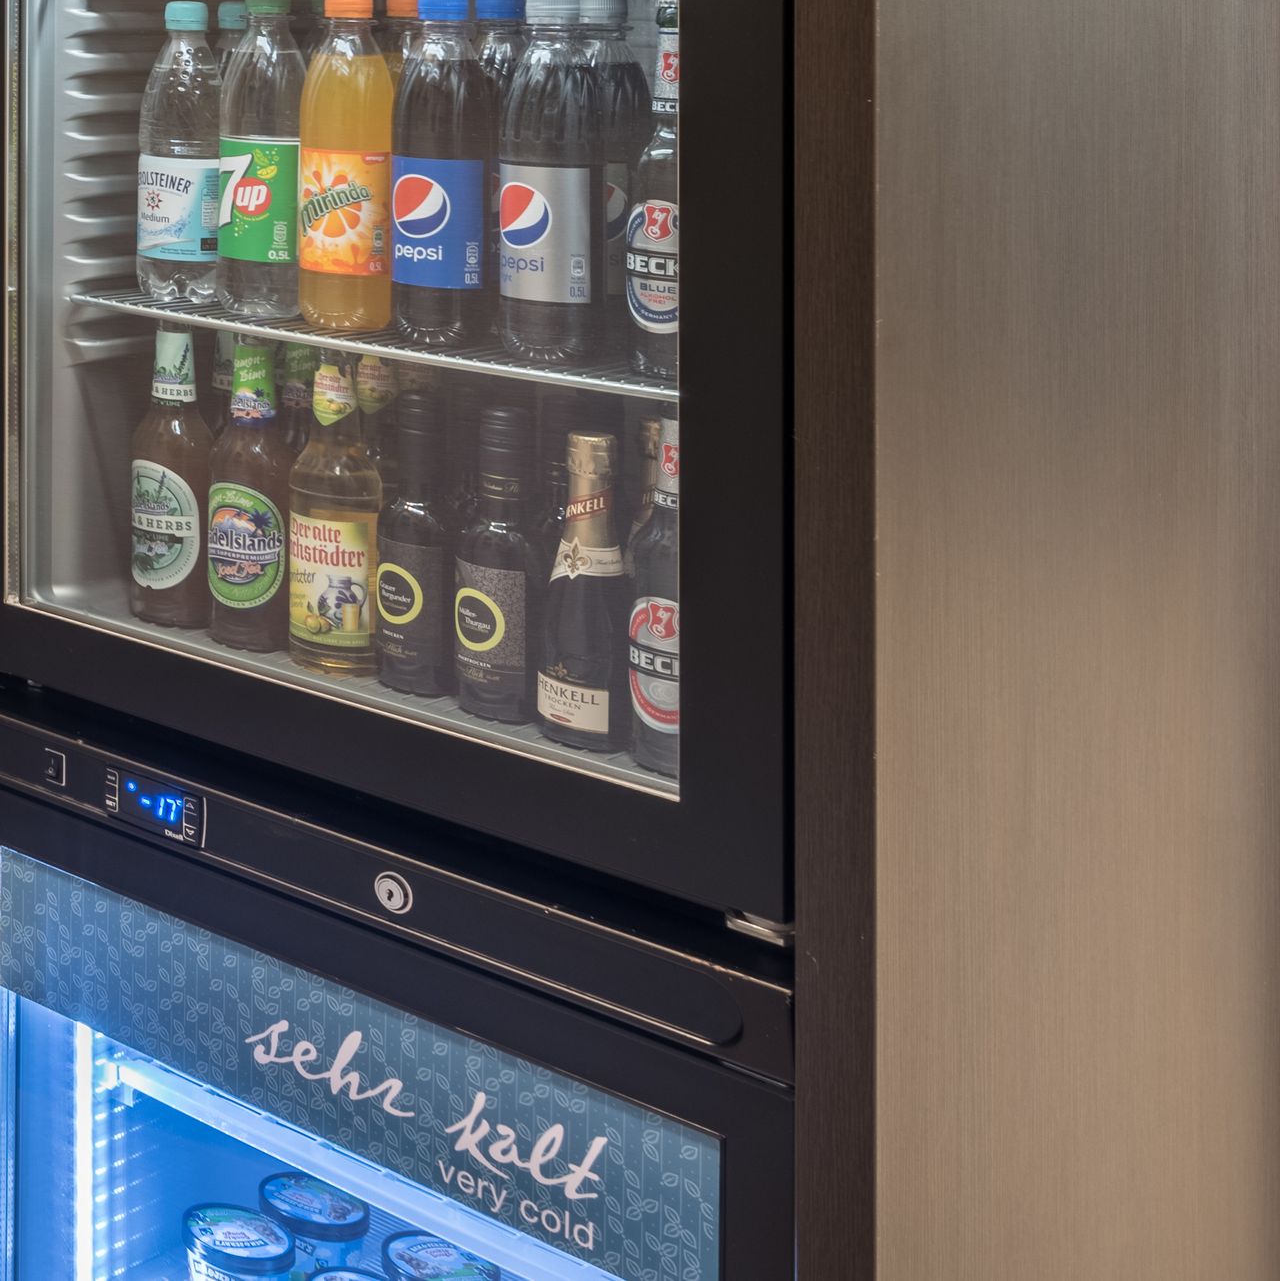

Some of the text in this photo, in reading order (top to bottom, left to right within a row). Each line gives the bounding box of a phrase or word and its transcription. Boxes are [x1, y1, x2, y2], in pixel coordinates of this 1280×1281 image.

[651, 100, 679, 112] BEC
[138, 171, 191, 194] ROLSTEINER
[301, 180, 372, 237] mirinda
[395, 244, 442, 262] pepsi
[626, 252, 679, 276] BECK
[640, 282, 677, 294] BLUE
[161, 388, 193, 397] HERBS
[566, 497, 605, 518] ENKELL
[654, 492, 678, 507] BEC
[146, 518, 192, 531] HERBS
[290, 517, 342, 544] Der alte
[289, 540, 365, 568] chstädter
[381, 589, 411, 603] Burgunder
[465, 616, 491, 630] Thurgau
[539, 678, 599, 706] HENKELL
[544, 694, 582, 710] TROCKEN
[245, 1019, 608, 1200] sehr kalt
[438, 1160, 595, 1251] very cold
